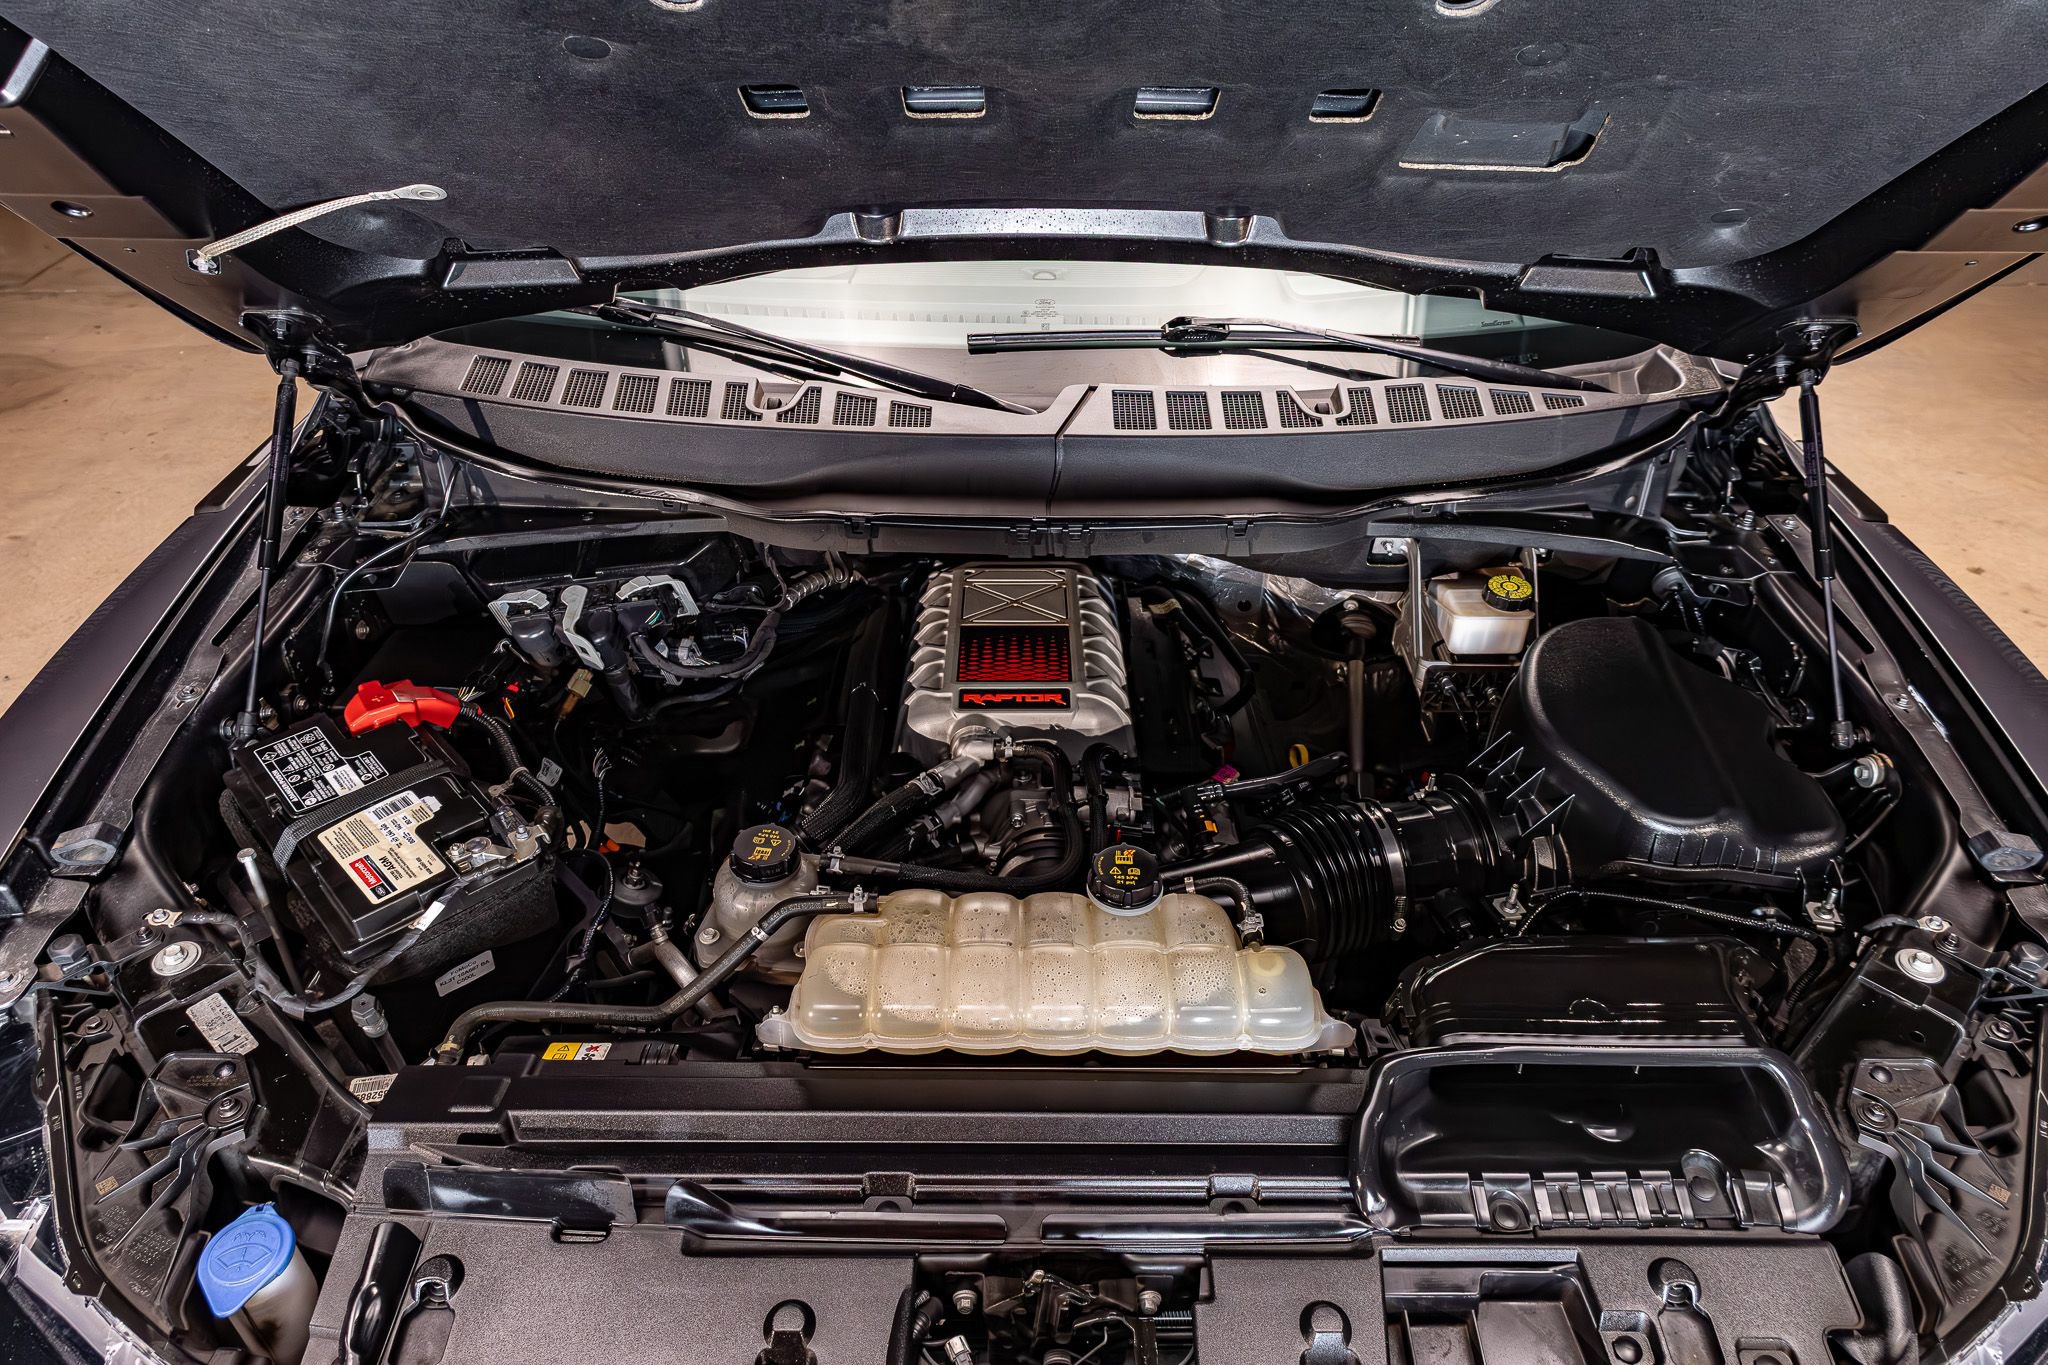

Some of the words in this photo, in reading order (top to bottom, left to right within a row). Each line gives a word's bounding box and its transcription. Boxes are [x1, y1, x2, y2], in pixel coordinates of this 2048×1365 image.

[963, 693, 1066, 705] RAPTOR
[379, 856, 396, 871] AGM
[354, 861, 378, 885] Motorcraft
